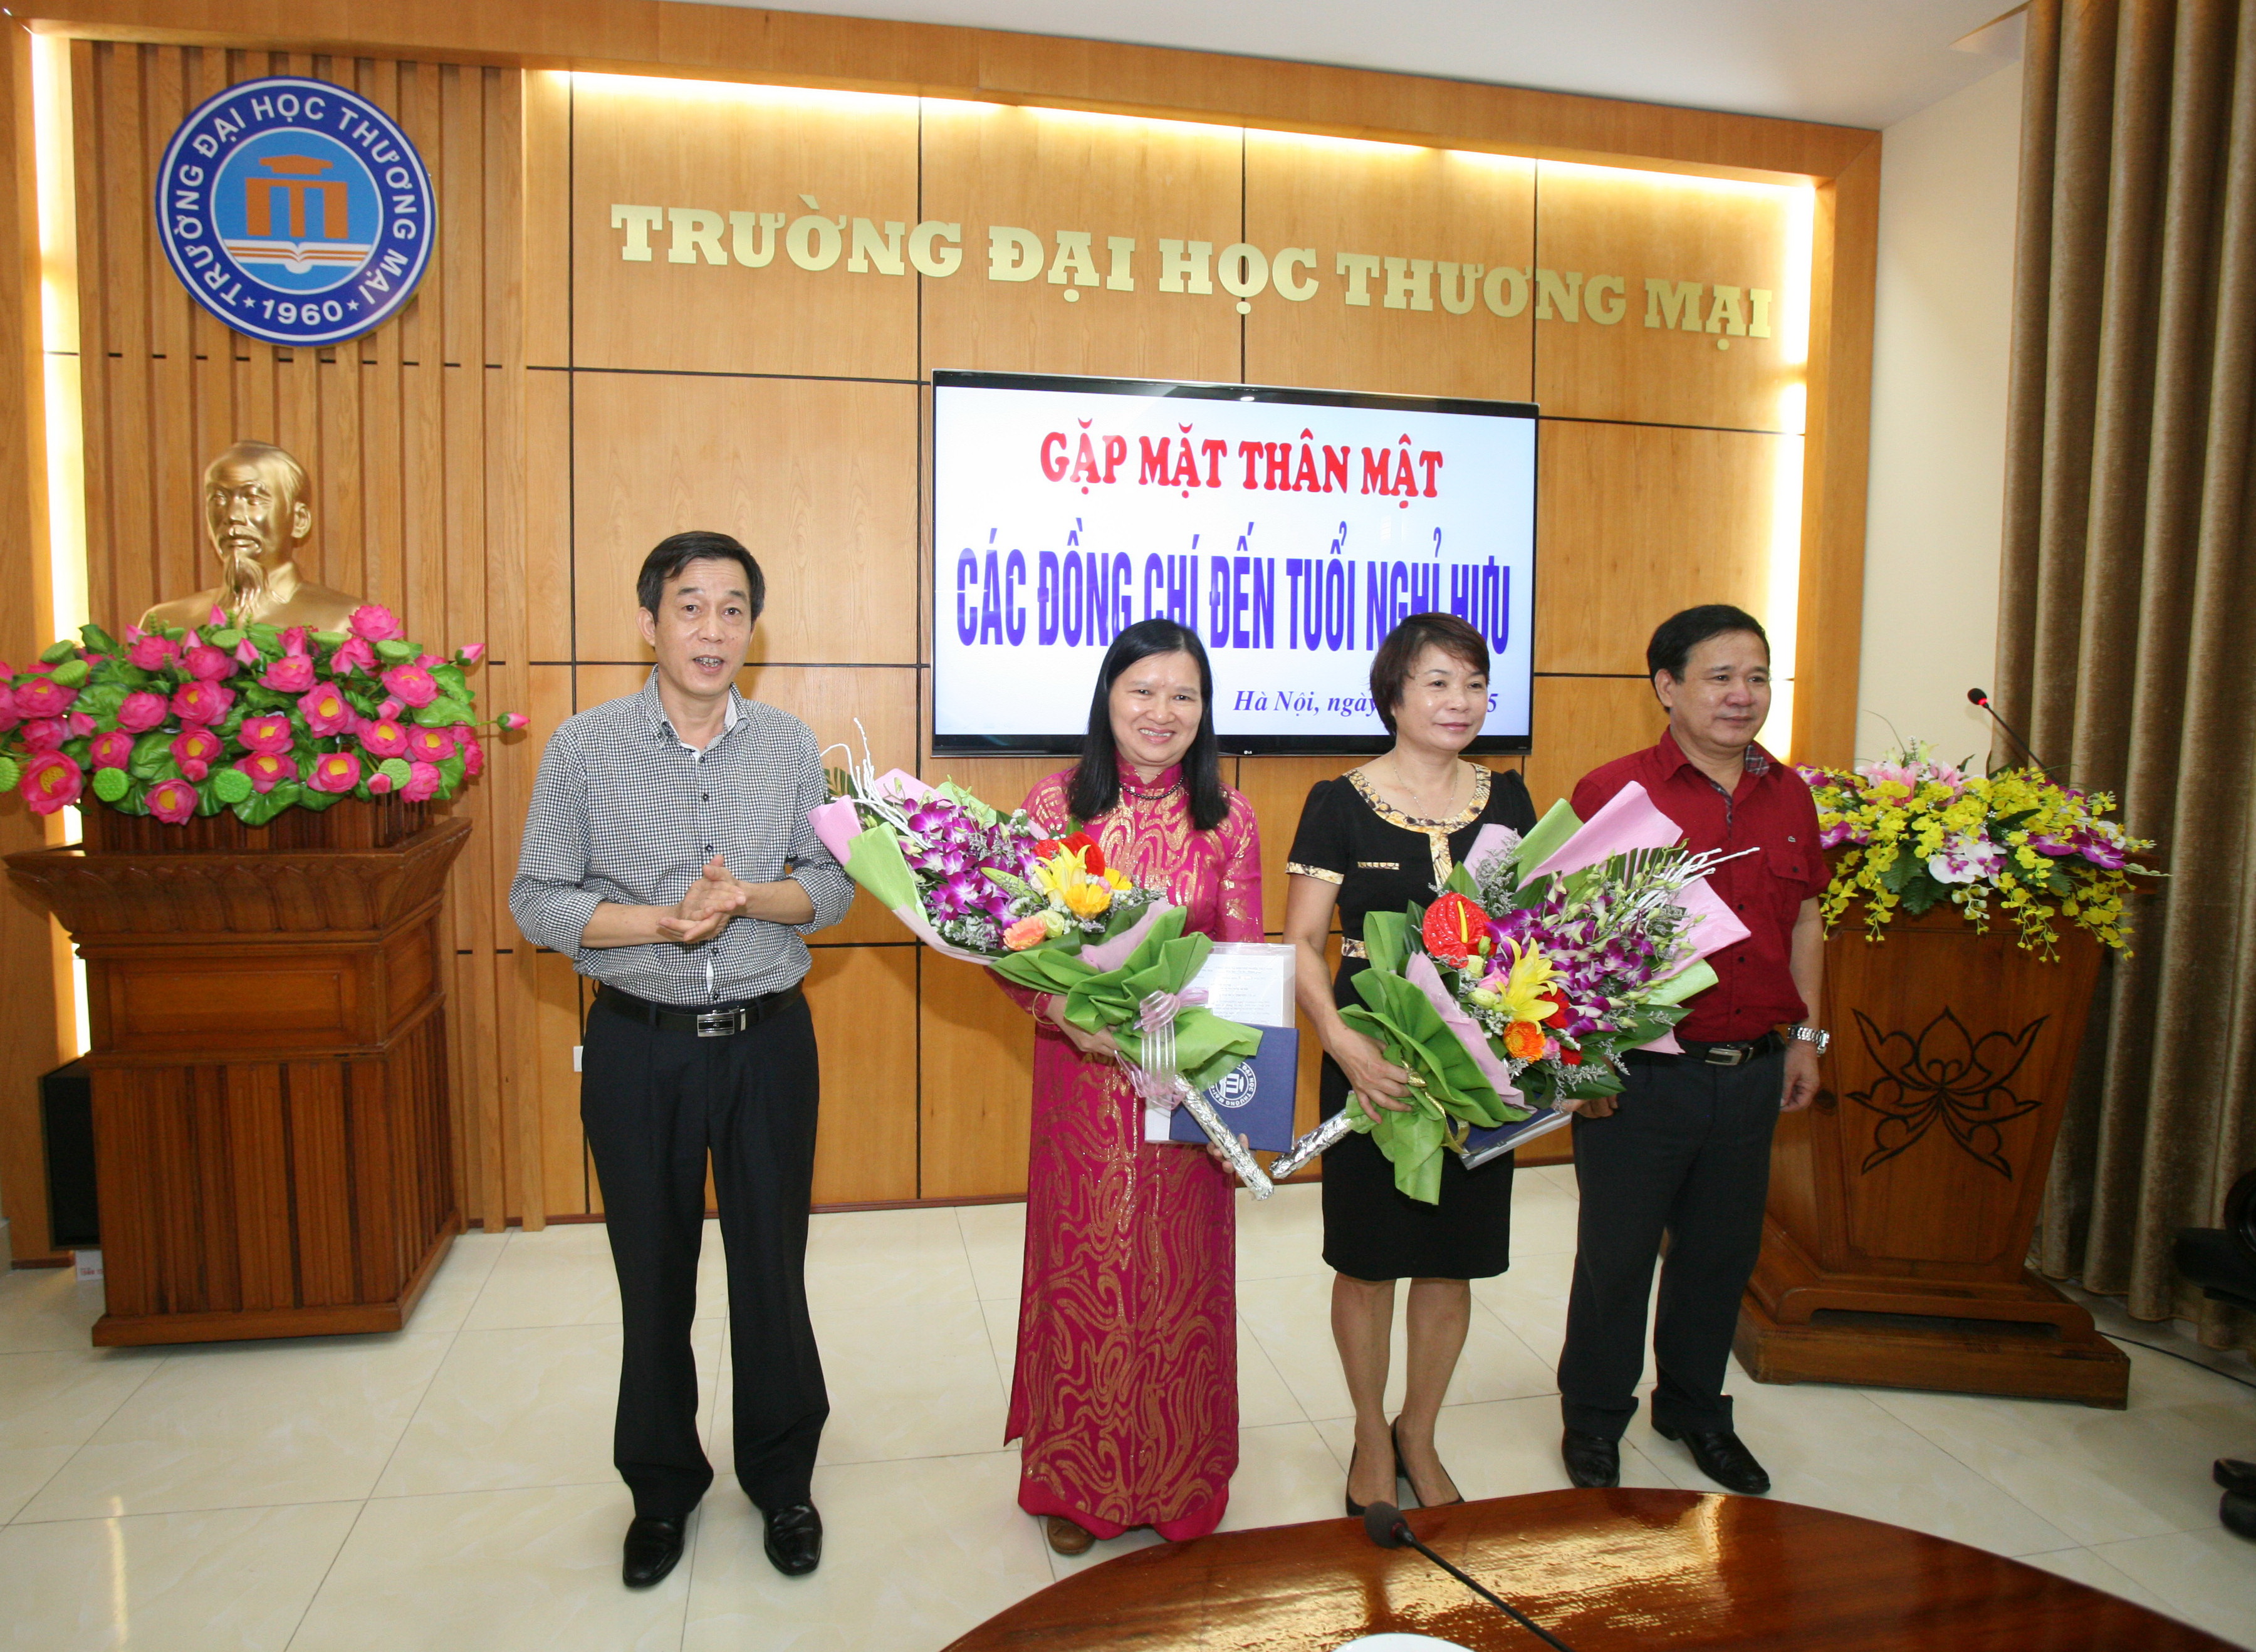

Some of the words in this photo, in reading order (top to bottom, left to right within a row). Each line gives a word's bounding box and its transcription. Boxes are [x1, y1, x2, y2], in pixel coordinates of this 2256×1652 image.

[192, 107, 246, 159] ĐẠI
[251, 93, 326, 122] HỌC
[339, 106, 417, 241] THƯƠNG
[174, 164, 242, 306] TRƯỜNG
[357, 248, 409, 305] MẠI
[611, 194, 963, 278] TRƯỜNG
[989, 225, 1136, 303] ĐẠI
[1158, 238, 1320, 315] HỌC
[1335, 252, 1627, 325] THƯƠNG
[1643, 278, 1772, 351] MẠI
[262, 298, 343, 325] 1960
[1040, 417, 1127, 495] GẶP
[1138, 422, 1228, 499] MẶT
[1238, 427, 1351, 494] THÂN
[1360, 433, 1444, 509] MẬT
[957, 528, 1026, 647] CÁC
[1037, 517, 1132, 647] ĐỒNG
[1144, 534, 1200, 635] CHÍ
[1209, 521, 1275, 649] ĐẾN
[1286, 521, 1355, 652] TUỔI
[1233, 690, 1268, 711] Hà
[1273, 691, 1319, 716] Nội,
[1327, 692, 1377, 717] ngày
